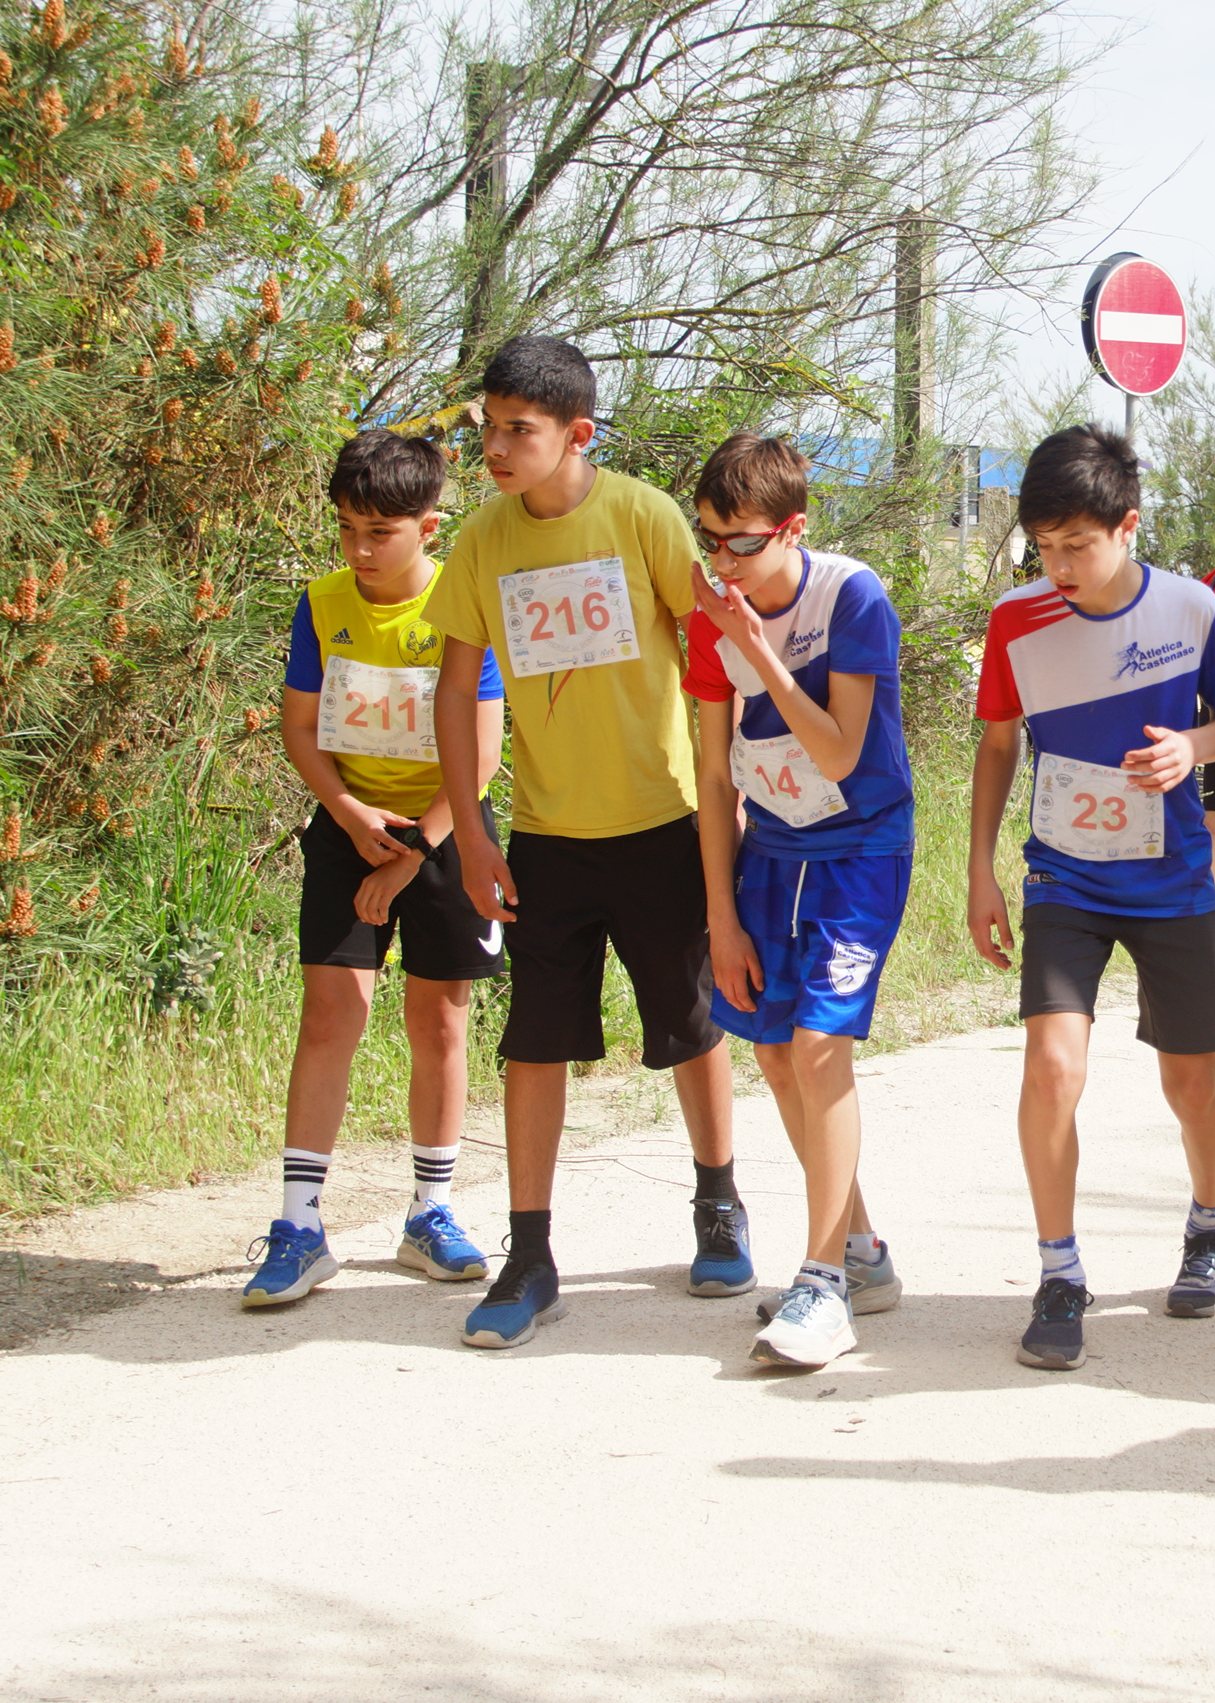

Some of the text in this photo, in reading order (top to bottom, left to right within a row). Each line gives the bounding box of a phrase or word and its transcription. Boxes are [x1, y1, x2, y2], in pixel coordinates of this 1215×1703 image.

[525, 591, 611, 641] 216
[330, 637, 354, 645] adidas
[1138, 646, 1195, 671] Castenaso
[1139, 641, 1183, 661] Atletica
[345, 691, 416, 732] 211
[754, 764, 802, 799] 14
[1071, 792, 1128, 832] 23
